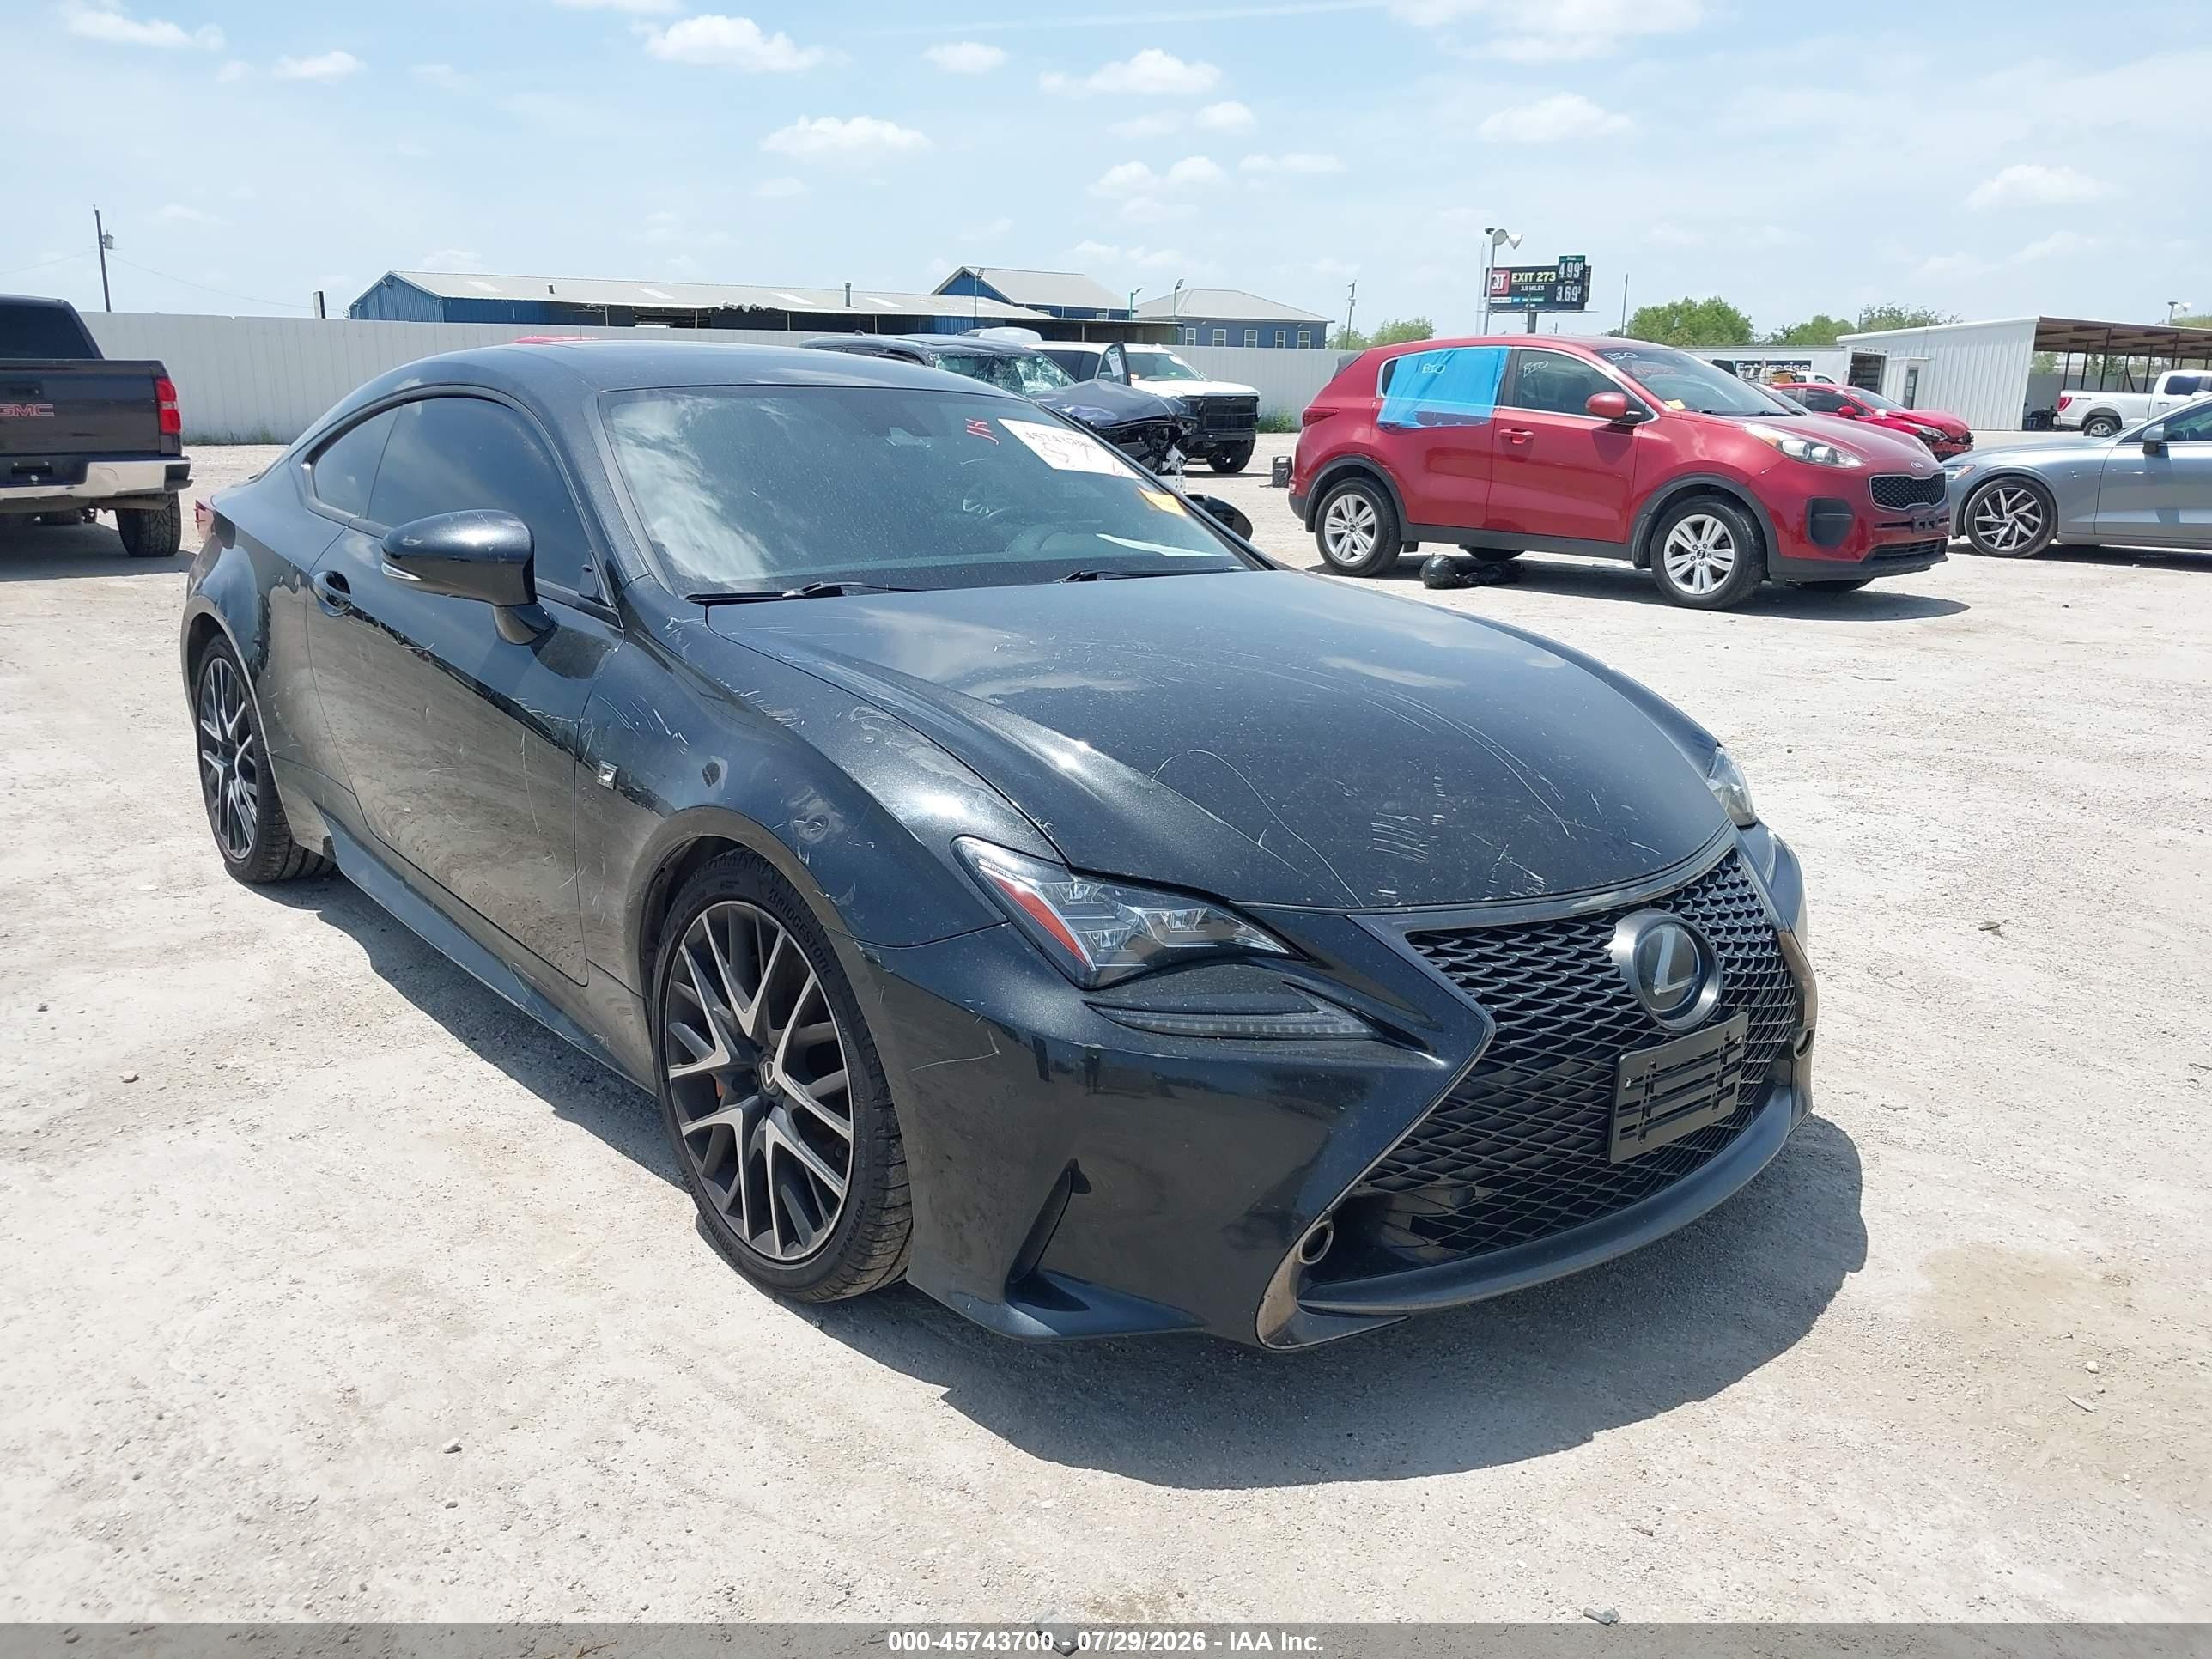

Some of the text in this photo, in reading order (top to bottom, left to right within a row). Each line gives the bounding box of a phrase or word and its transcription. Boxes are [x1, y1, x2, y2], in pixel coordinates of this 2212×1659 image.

[1511, 271, 1556, 283] EXIT 273
[0, 404, 54, 417] GMC
